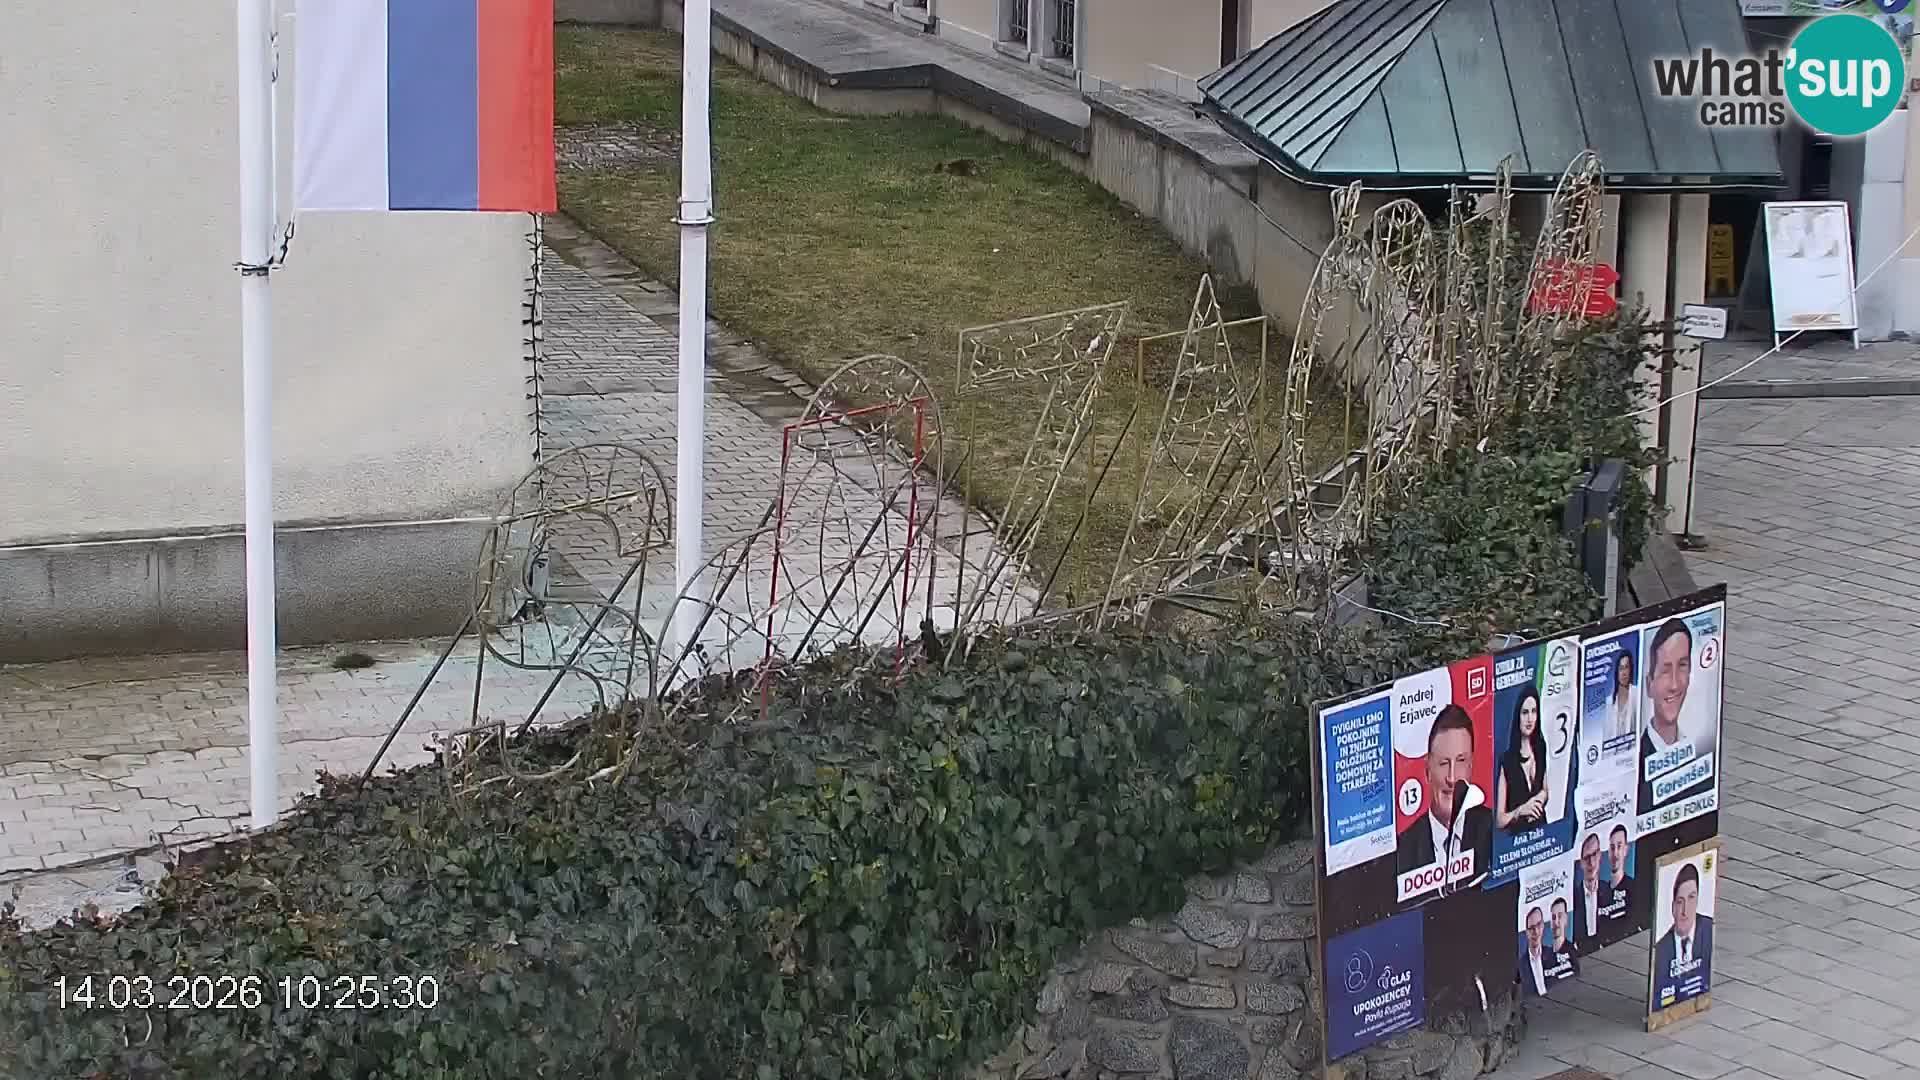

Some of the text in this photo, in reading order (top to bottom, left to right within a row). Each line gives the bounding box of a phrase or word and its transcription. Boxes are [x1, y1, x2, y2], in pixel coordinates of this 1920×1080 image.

[1705, 647, 1713, 661] 2
[1471, 677, 1482, 689] SD
[1400, 685, 1433, 707] Andrej
[1332, 711, 1383, 737] DVIGNILI SMO
[1400, 705, 1437, 724] Erjavec
[1337, 723, 1380, 746] POKOJNINE
[1554, 711, 1568, 755] 3
[1340, 736, 1379, 758] IN ZNIŽALI
[1336, 749, 1379, 772] POLOŽNICE
[1336, 757, 1384, 784] DOMOVIH ZA
[1647, 744, 1693, 775] Boštjan
[1656, 760, 1710, 798] Gorenšek
[1404, 787, 1418, 806] 13
[1684, 795, 1714, 816] FOKUS
[1514, 834, 1528, 846] Ana
[1348, 957, 1363, 989] 8
[1390, 970, 1411, 987] GLAS
[1353, 984, 1411, 1016] UPOKOJENCEV
